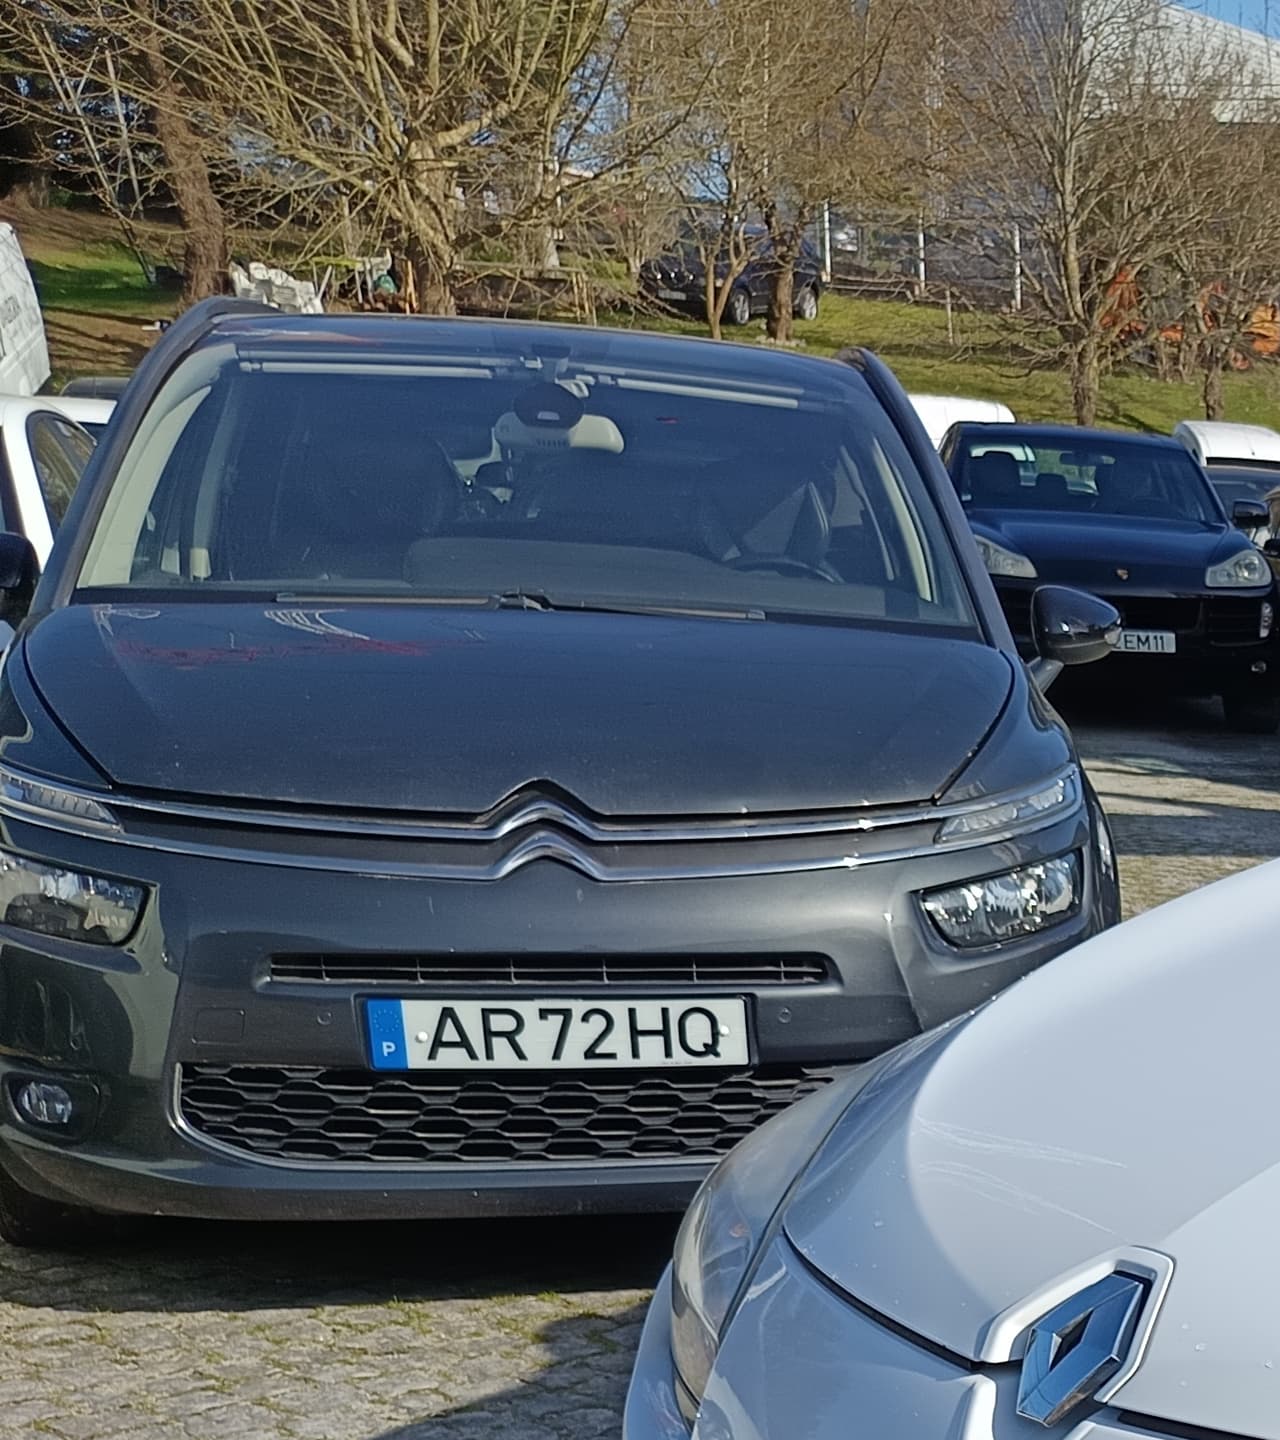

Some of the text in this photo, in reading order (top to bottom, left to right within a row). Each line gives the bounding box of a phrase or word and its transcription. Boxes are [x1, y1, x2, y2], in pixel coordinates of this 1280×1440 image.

[1114, 633, 1166, 651] EM11
[382, 1006, 722, 1061] P AR72HQ
